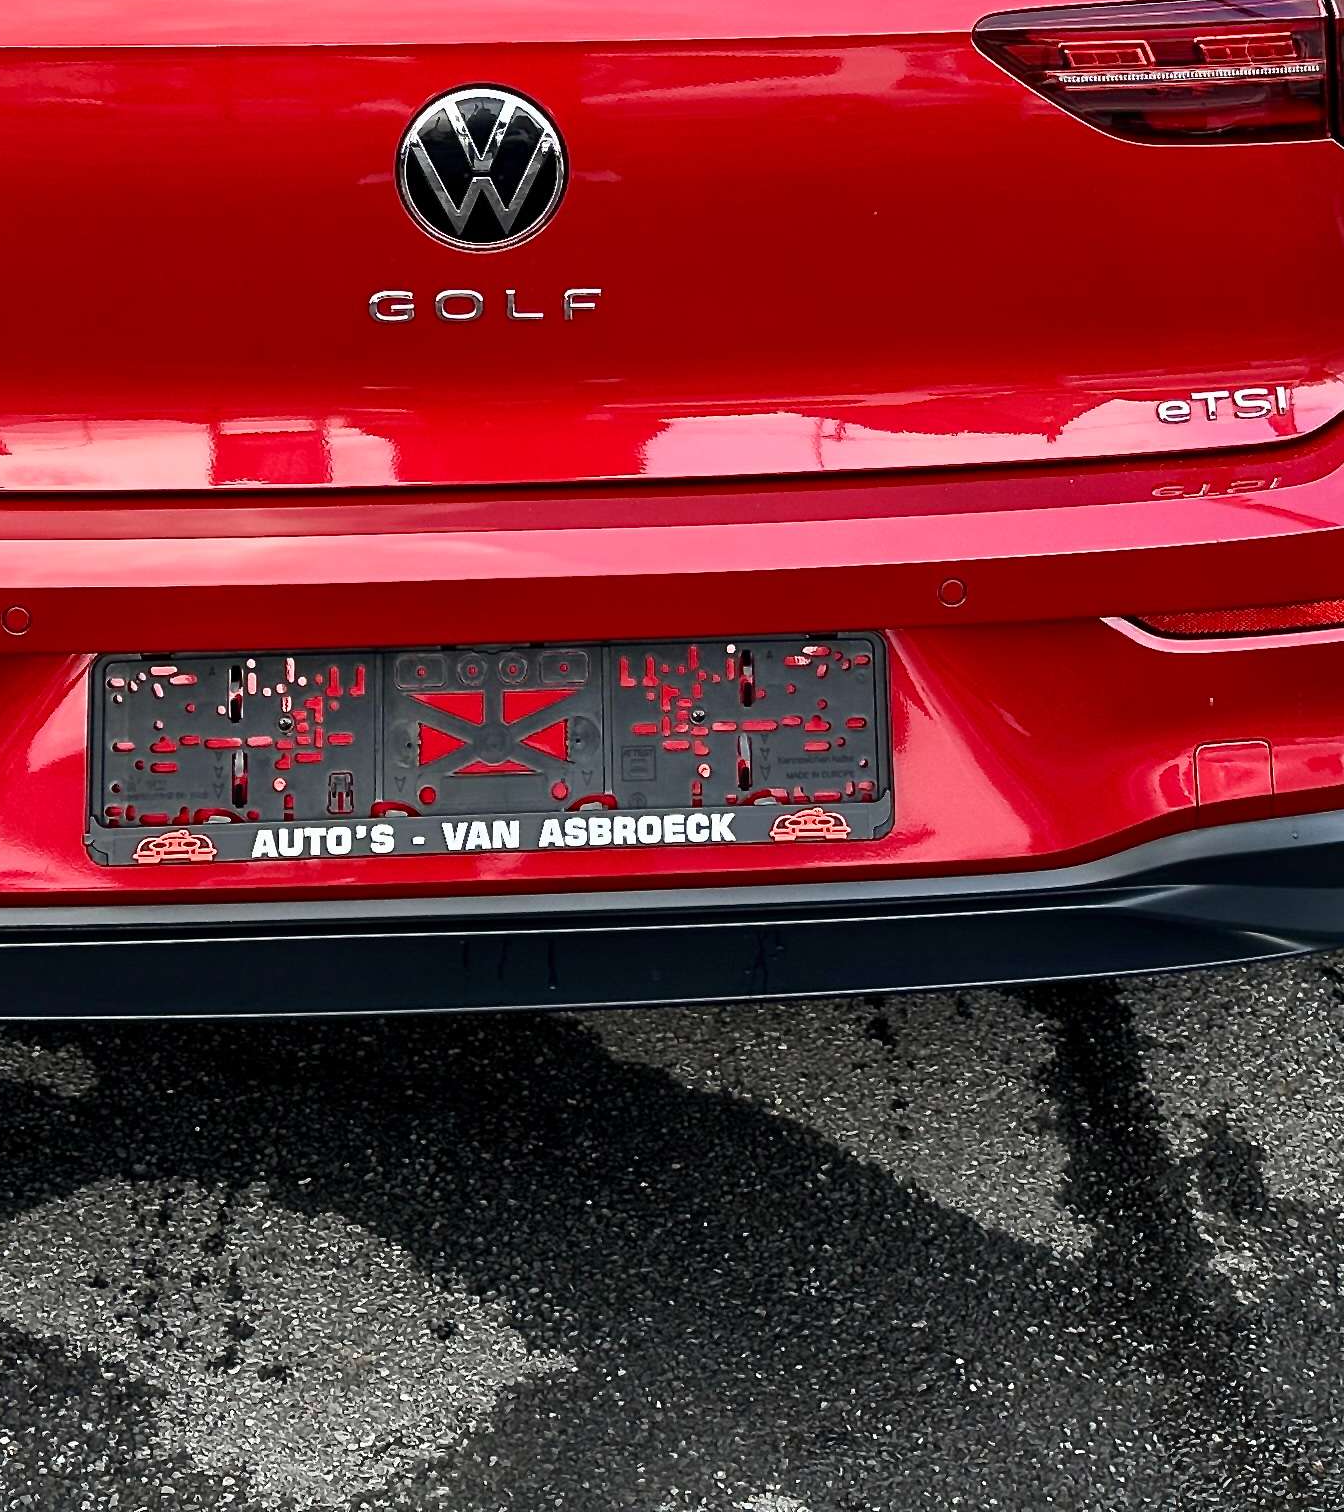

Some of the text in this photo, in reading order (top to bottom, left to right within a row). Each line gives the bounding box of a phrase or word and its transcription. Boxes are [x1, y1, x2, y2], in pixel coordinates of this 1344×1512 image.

[367, 287, 605, 323] GOLF
[1157, 386, 1288, 424] eTSI
[251, 824, 394, 858] AUTO'S
[441, 820, 520, 850] VAN
[538, 813, 736, 848] ASBROECK
